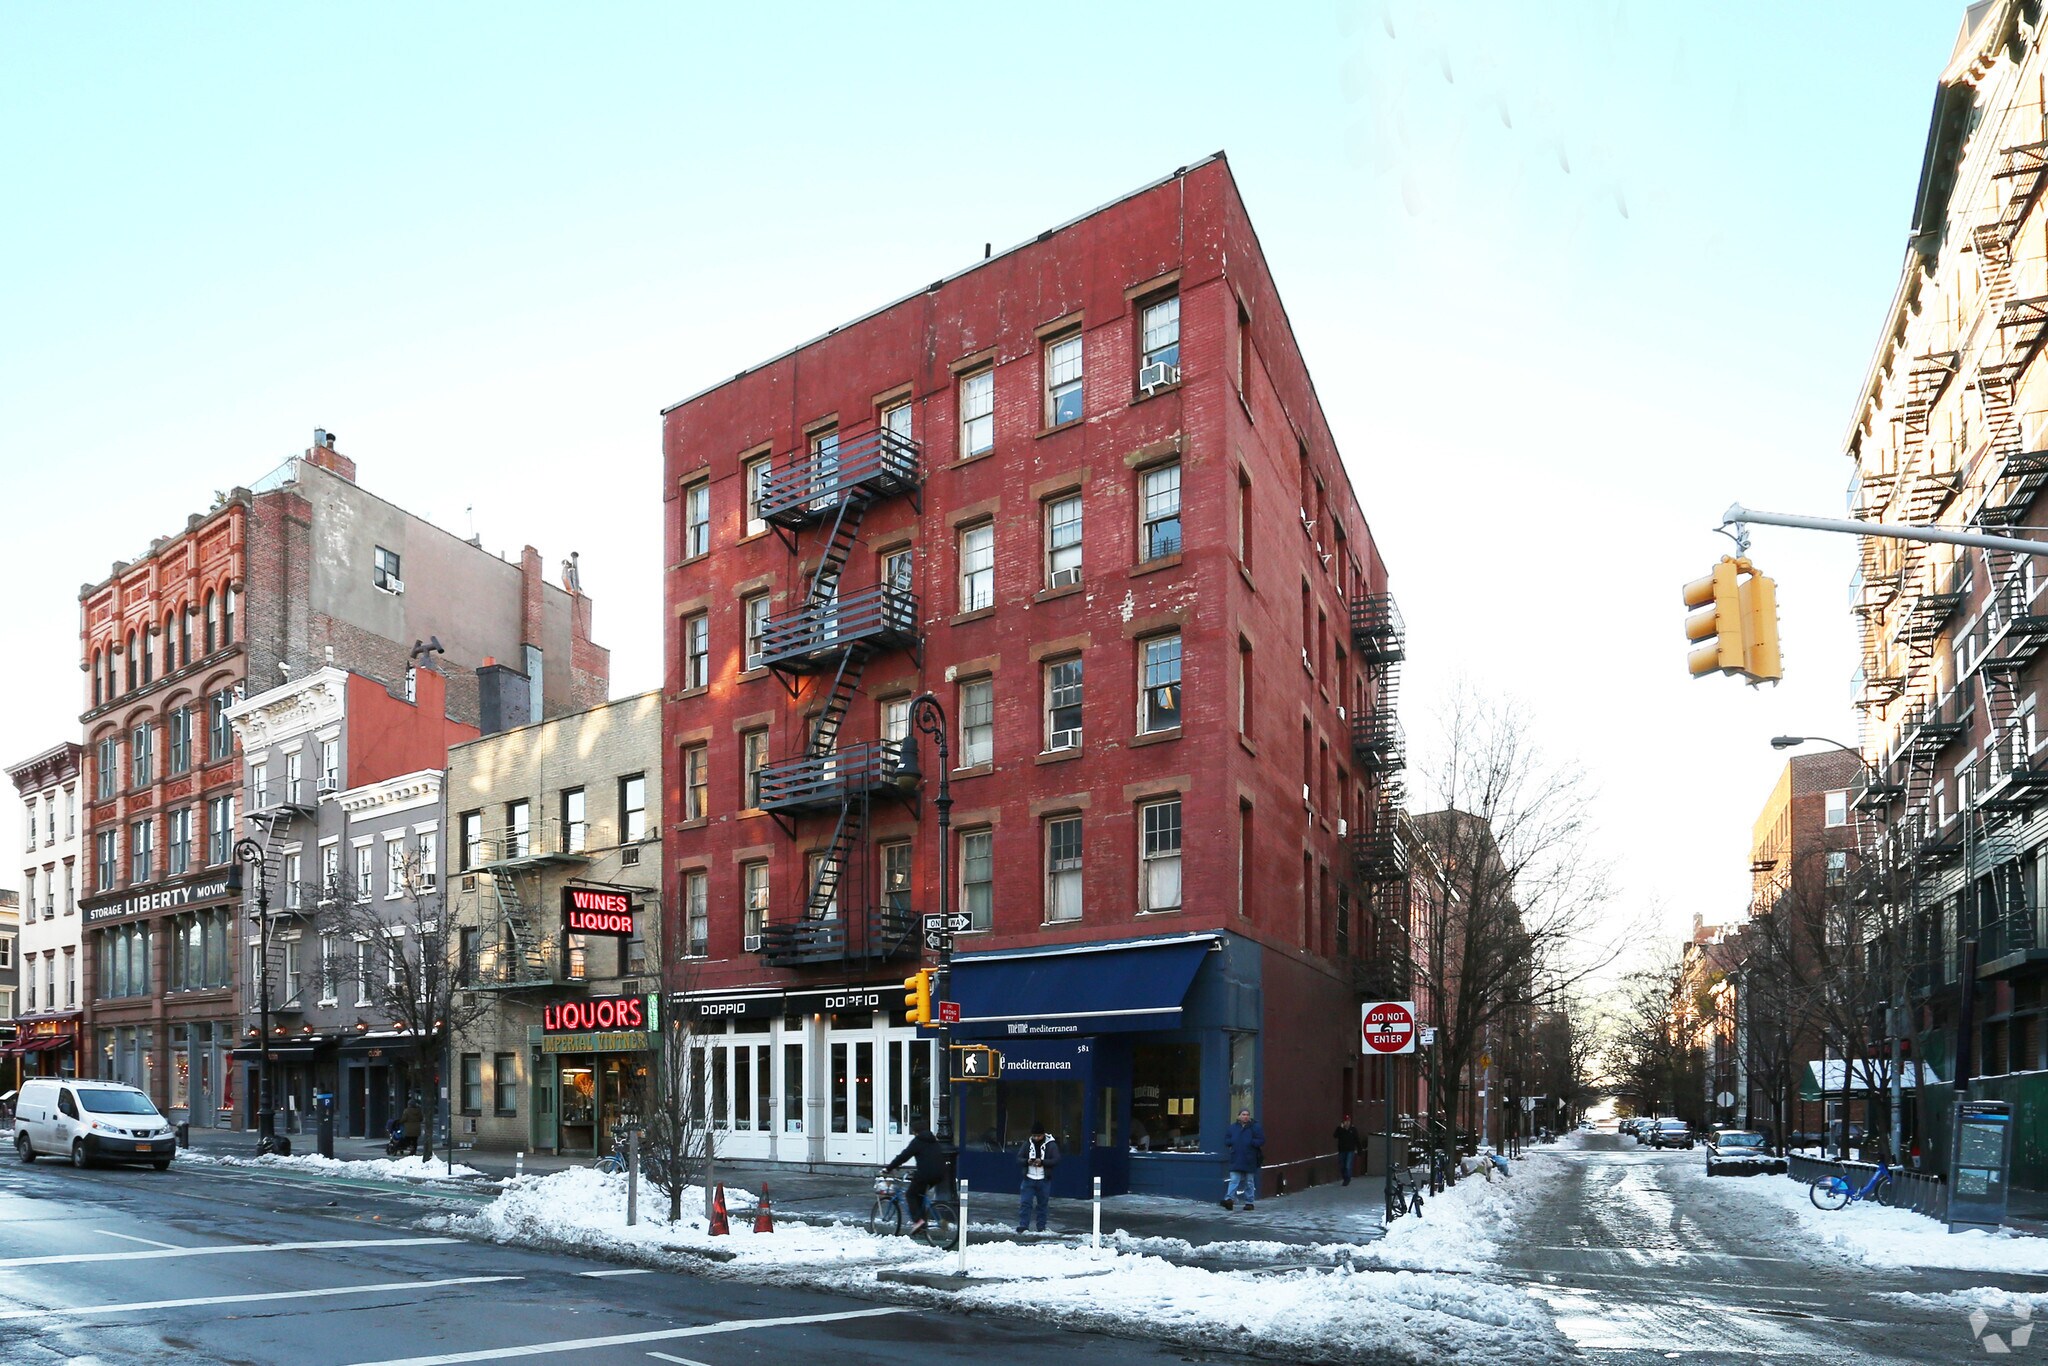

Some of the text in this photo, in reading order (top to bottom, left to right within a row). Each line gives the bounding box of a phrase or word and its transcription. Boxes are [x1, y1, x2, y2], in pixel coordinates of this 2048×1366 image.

[90, 881, 229, 920] STORAGE LIBERTY MOVIN
[573, 891, 627, 913] WINES
[570, 912, 632, 932] LIQUOR
[930, 919, 941, 928] ON
[545, 998, 643, 1030] LIQUORS
[701, 1003, 746, 1015] DOPPIO
[1371, 1012, 1404, 1021] DO NOT
[1029, 1024, 1078, 1033] mediterranean
[542, 1034, 593, 1052] IMPERIAL
[1374, 1035, 1402, 1044] ENTER
[1077, 1045, 1089, 1054] 581
[1007, 1059, 1071, 1070] mediterranean
[324, 1098, 330, 1106] P
